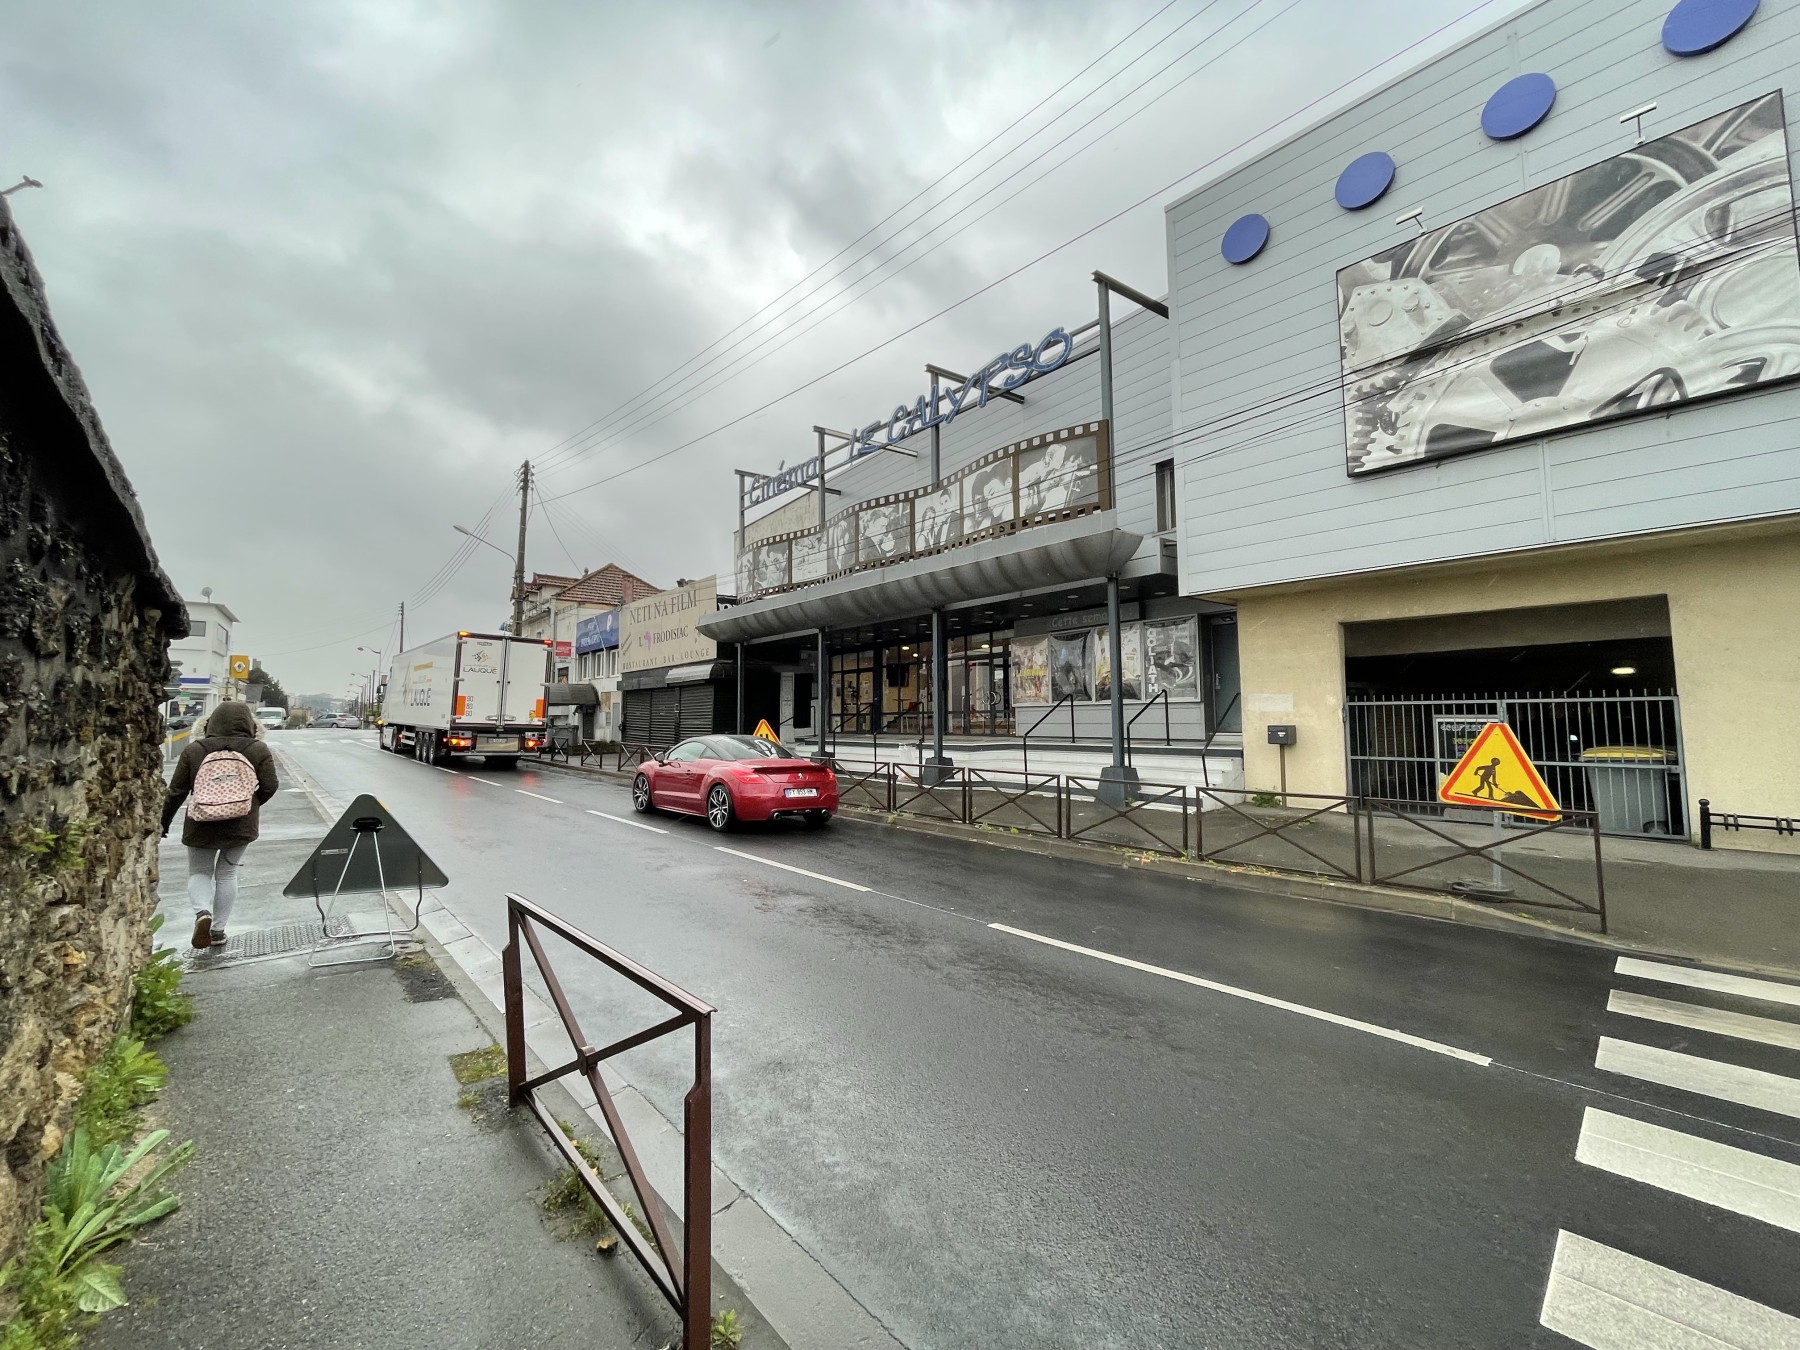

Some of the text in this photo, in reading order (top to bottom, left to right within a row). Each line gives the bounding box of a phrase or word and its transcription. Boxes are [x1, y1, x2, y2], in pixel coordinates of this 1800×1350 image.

[887, 326, 1073, 444] CALYPSO
[629, 589, 697, 625] NETI NA FILM
[681, 647, 710, 660] LOUNGE
[1146, 628, 1159, 693] GOLIATH
